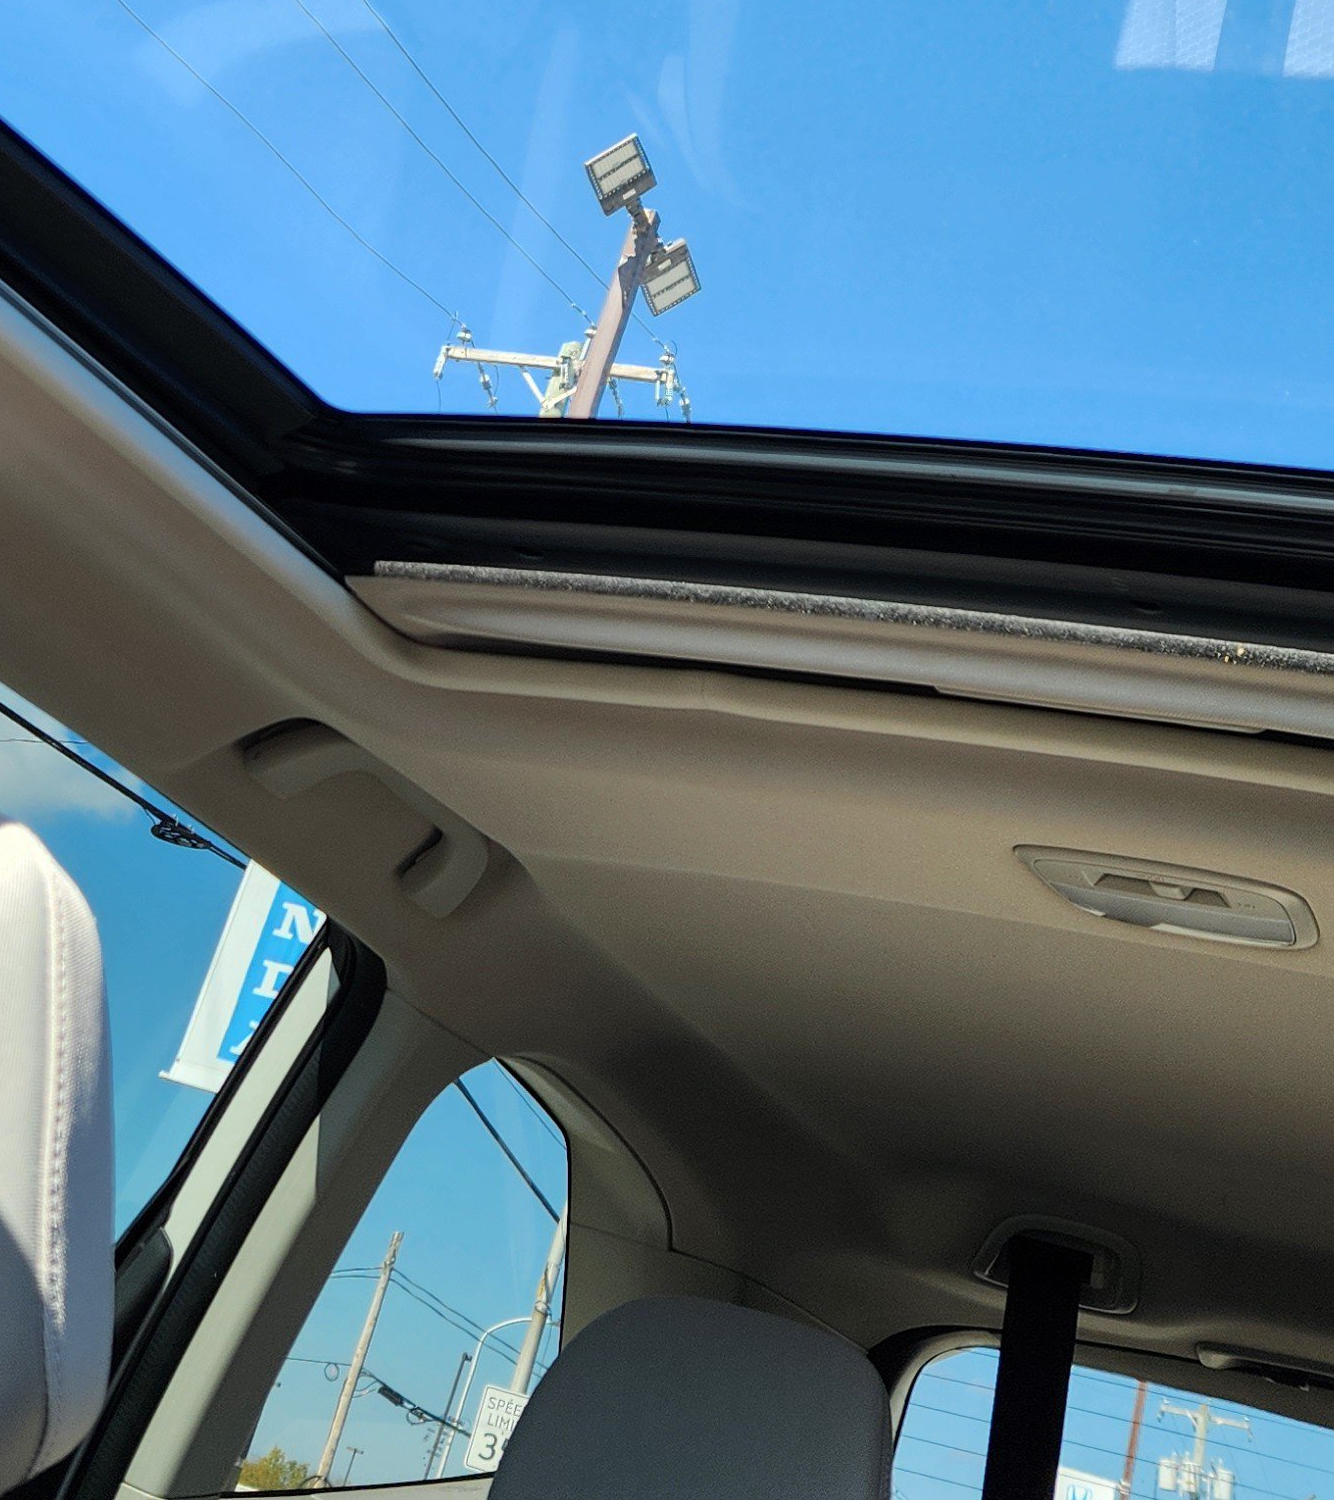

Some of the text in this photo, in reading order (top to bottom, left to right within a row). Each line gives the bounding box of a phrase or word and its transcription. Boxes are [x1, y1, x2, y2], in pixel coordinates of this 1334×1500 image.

[487, 1396, 524, 1417] SPEE
[487, 1412, 516, 1431] LIMI
[478, 1432, 508, 1460] 3
